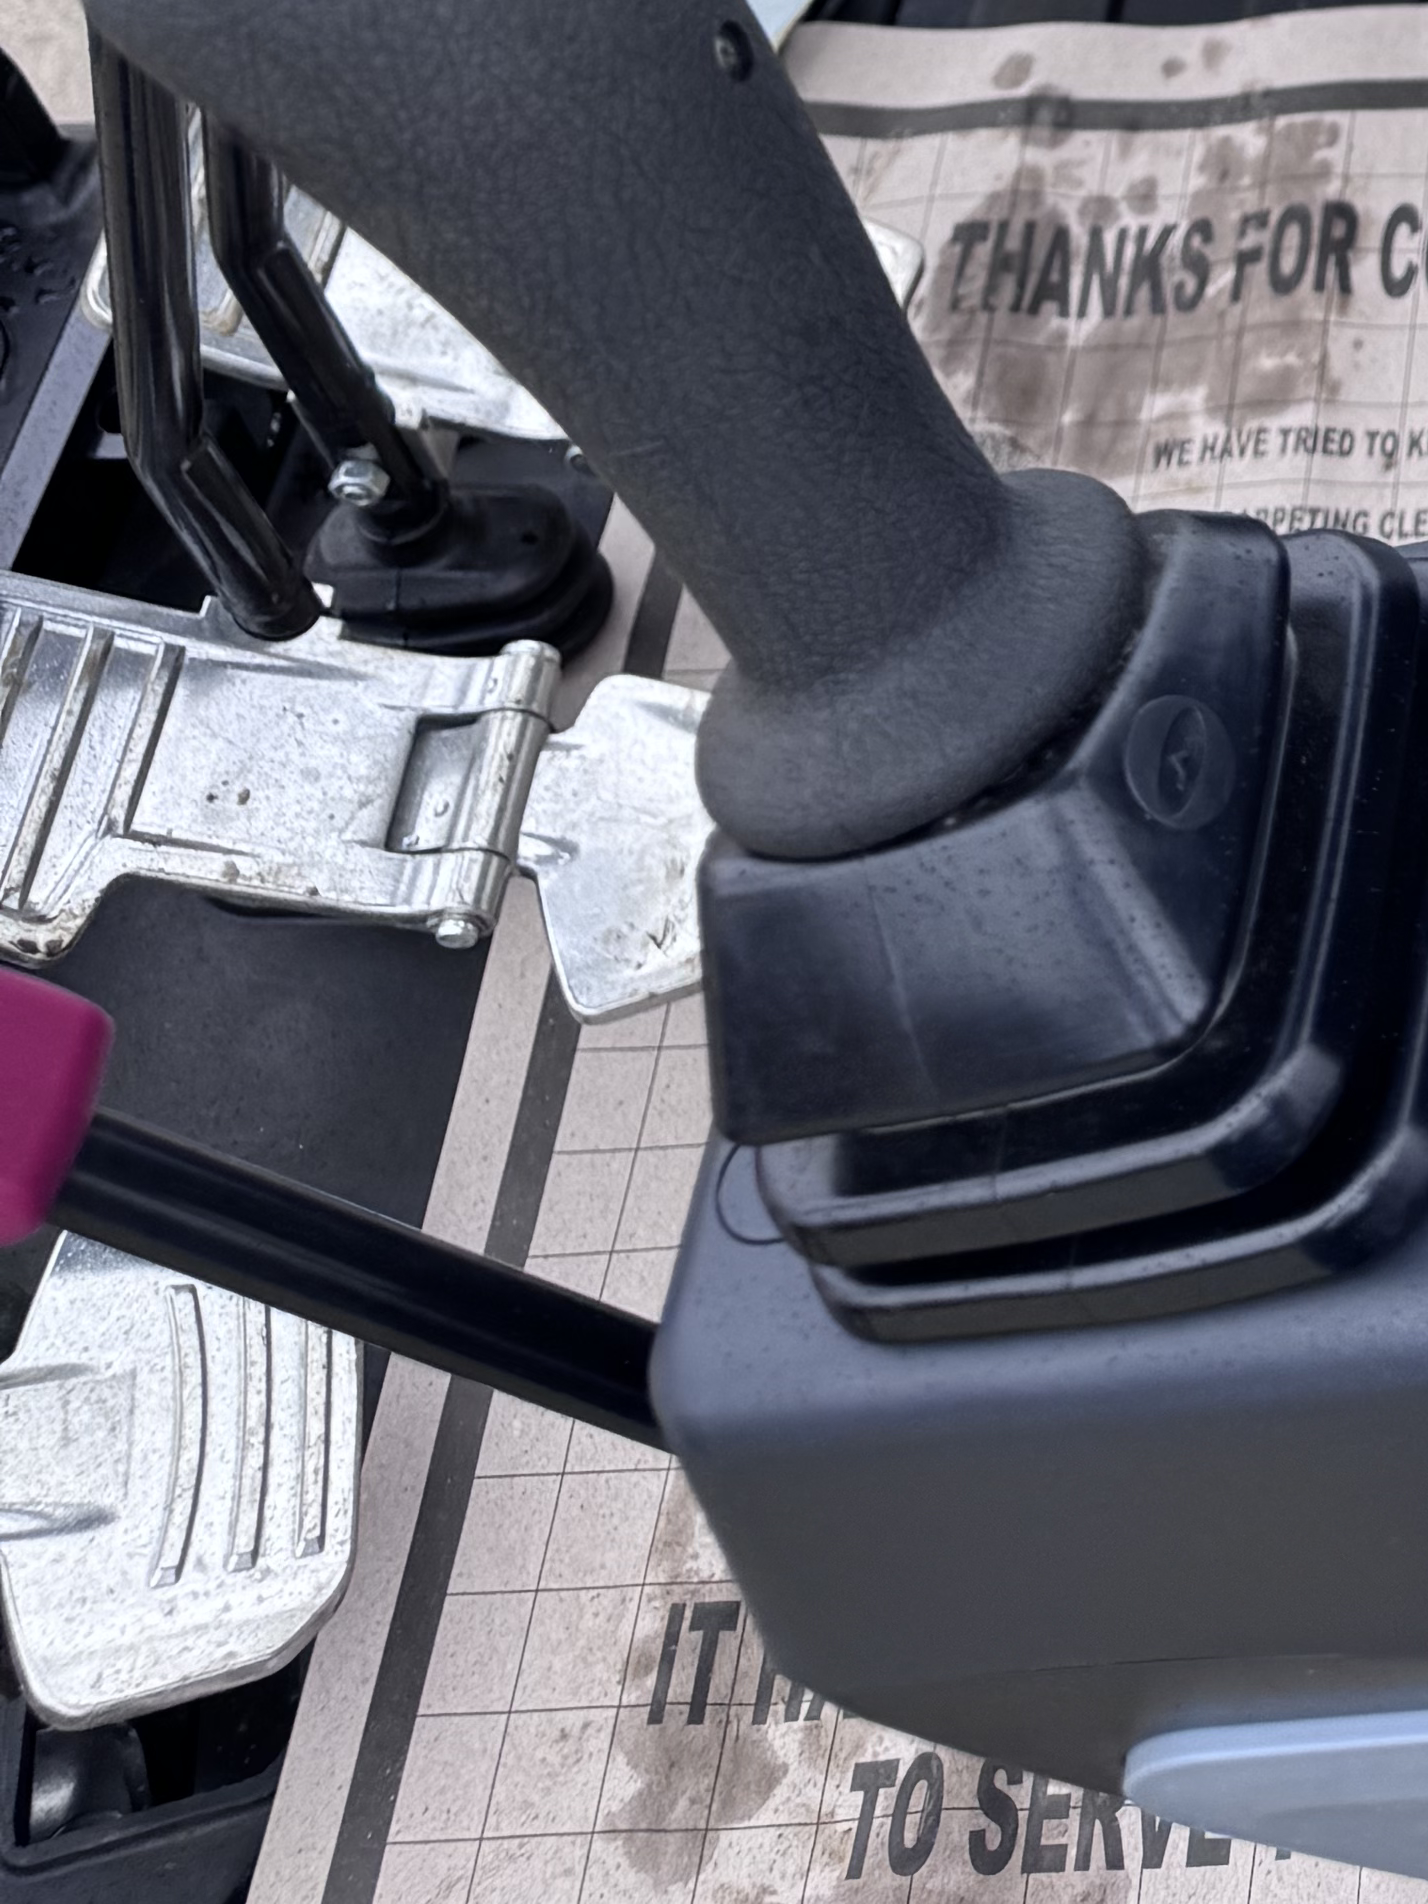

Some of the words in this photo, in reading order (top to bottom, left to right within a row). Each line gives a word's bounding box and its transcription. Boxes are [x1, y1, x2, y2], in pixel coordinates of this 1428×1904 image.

[949, 217, 1215, 318] THANKS
[1230, 199, 1359, 304] FOR
[1151, 438, 1193, 470] WE
[1198, 426, 1269, 463] HAVE
[1279, 425, 1355, 456] TRIED
[1366, 430, 1399, 458] TO
[647, 1600, 742, 1725] IT
[845, 1751, 944, 1881] TO
